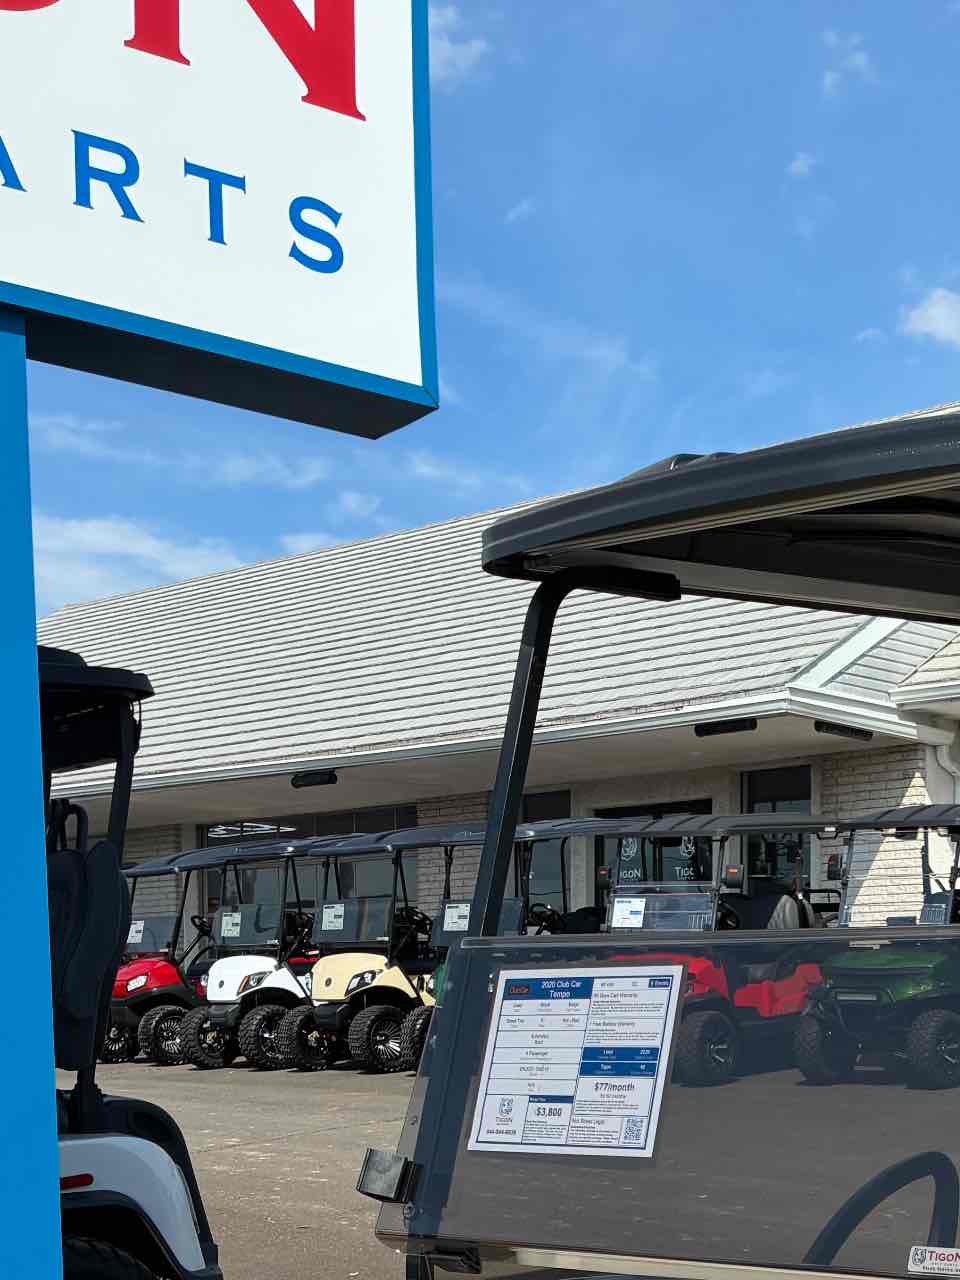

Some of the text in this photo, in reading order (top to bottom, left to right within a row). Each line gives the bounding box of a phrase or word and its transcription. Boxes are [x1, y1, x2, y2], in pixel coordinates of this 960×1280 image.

[556, 980, 570, 988] Club
[570, 980, 582, 988] Car
[594, 1081, 635, 1092] $77/month
[536, 1106, 563, 1117] $3,800
